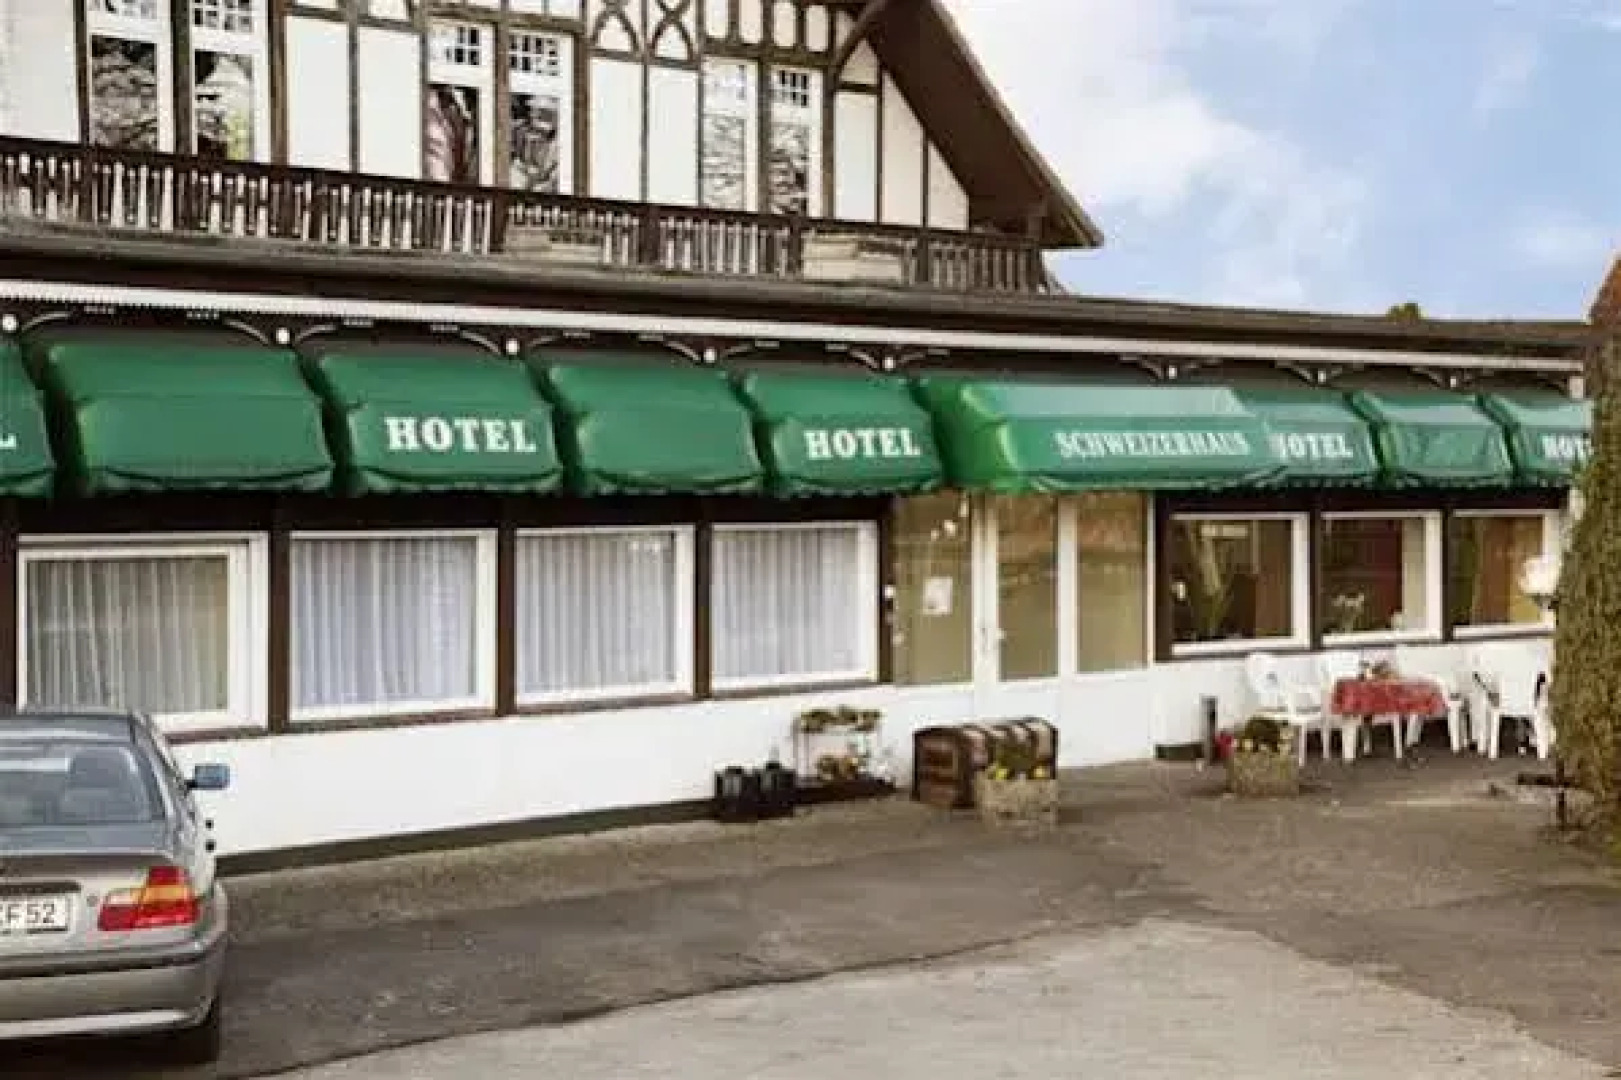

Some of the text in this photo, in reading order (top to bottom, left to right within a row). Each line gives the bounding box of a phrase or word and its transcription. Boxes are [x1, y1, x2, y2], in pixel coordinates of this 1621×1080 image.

[384, 416, 537, 453] HOTEL
[803, 428, 921, 460] HOTEL
[0, 903, 55, 924] F 52
